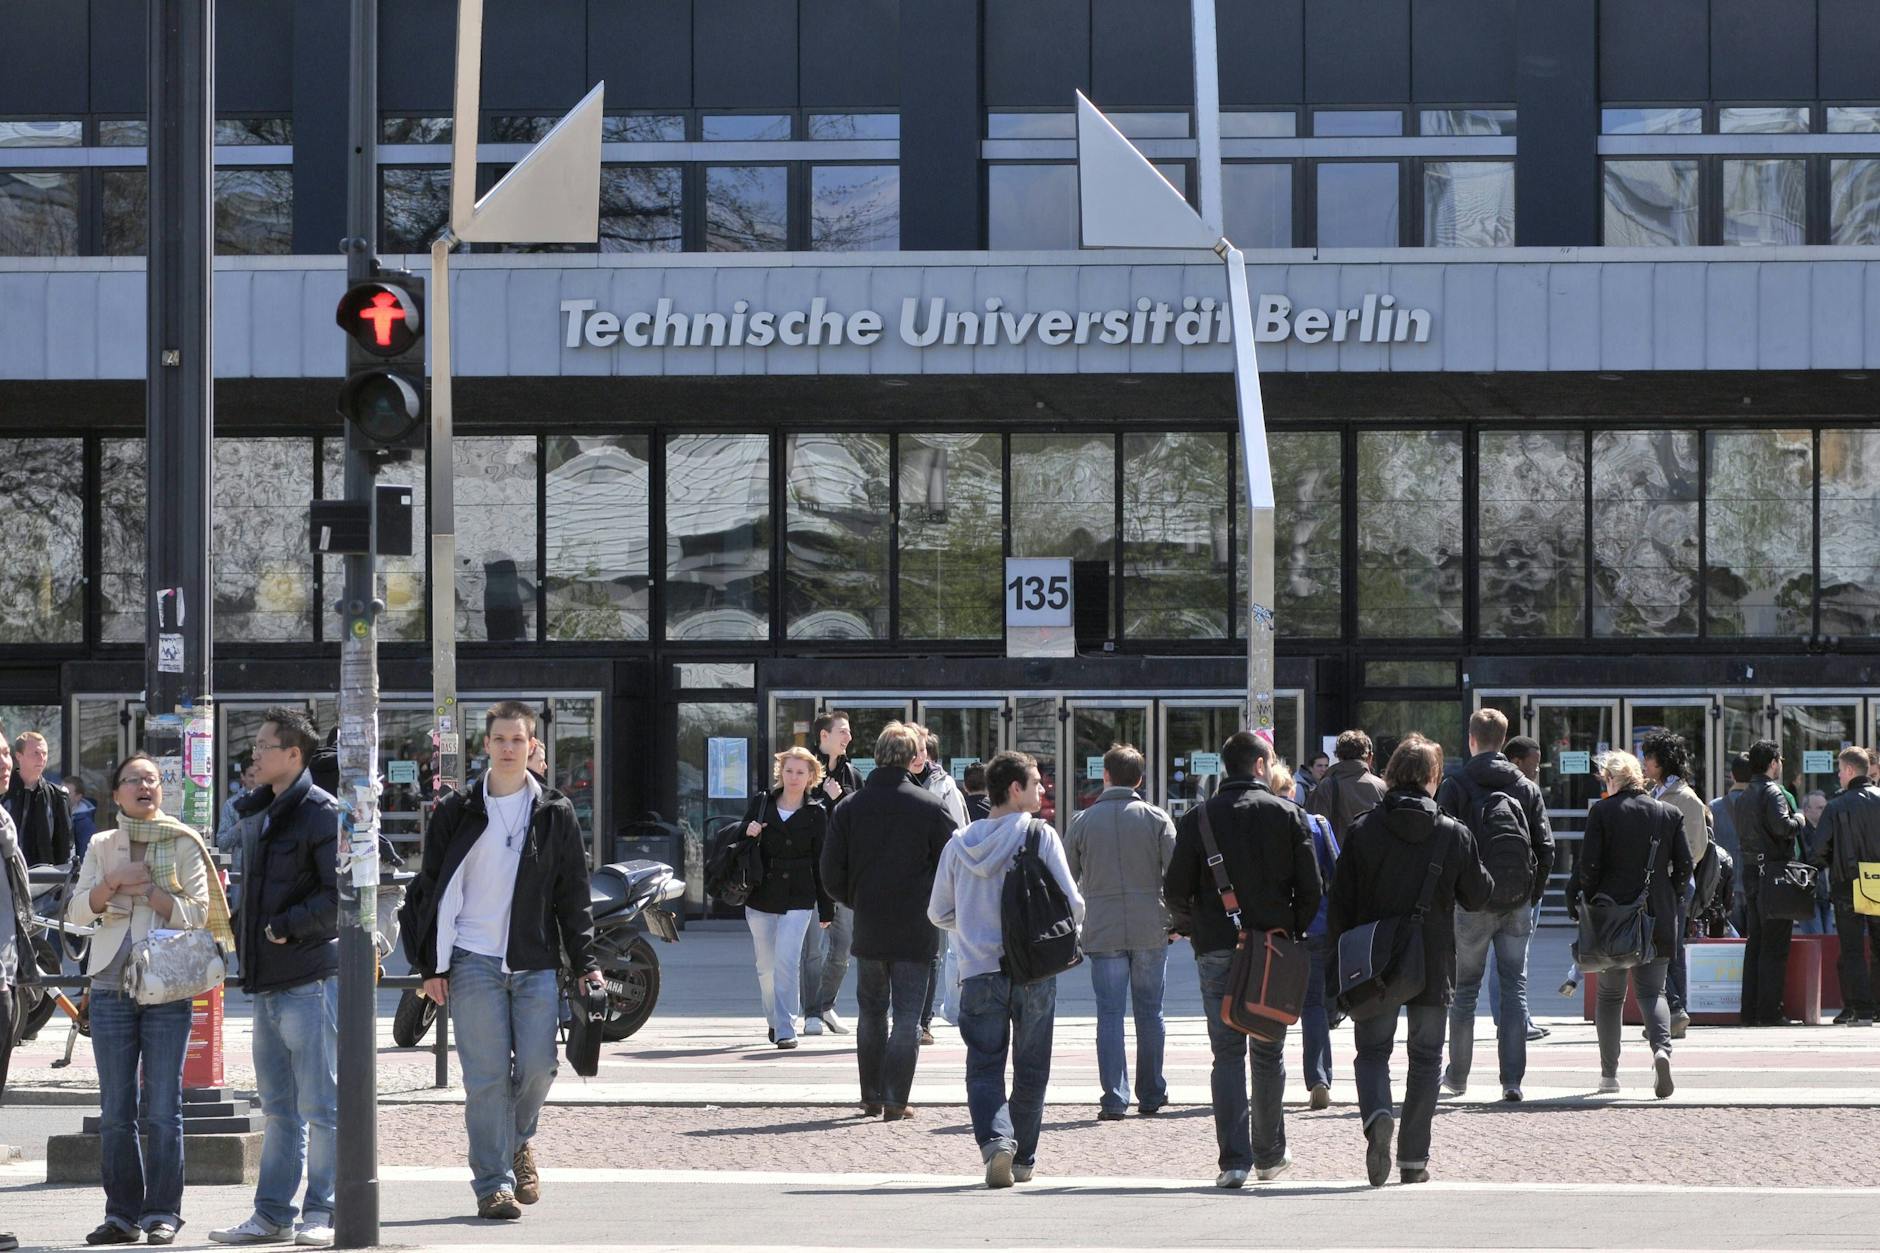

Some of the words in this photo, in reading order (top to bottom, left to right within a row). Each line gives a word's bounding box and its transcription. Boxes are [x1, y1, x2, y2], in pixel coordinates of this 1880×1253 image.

[560, 296, 884, 348] Technische
[899, 295, 1232, 347] Universität
[1254, 293, 1432, 344] Berlin
[1008, 575, 1070, 611] 135
